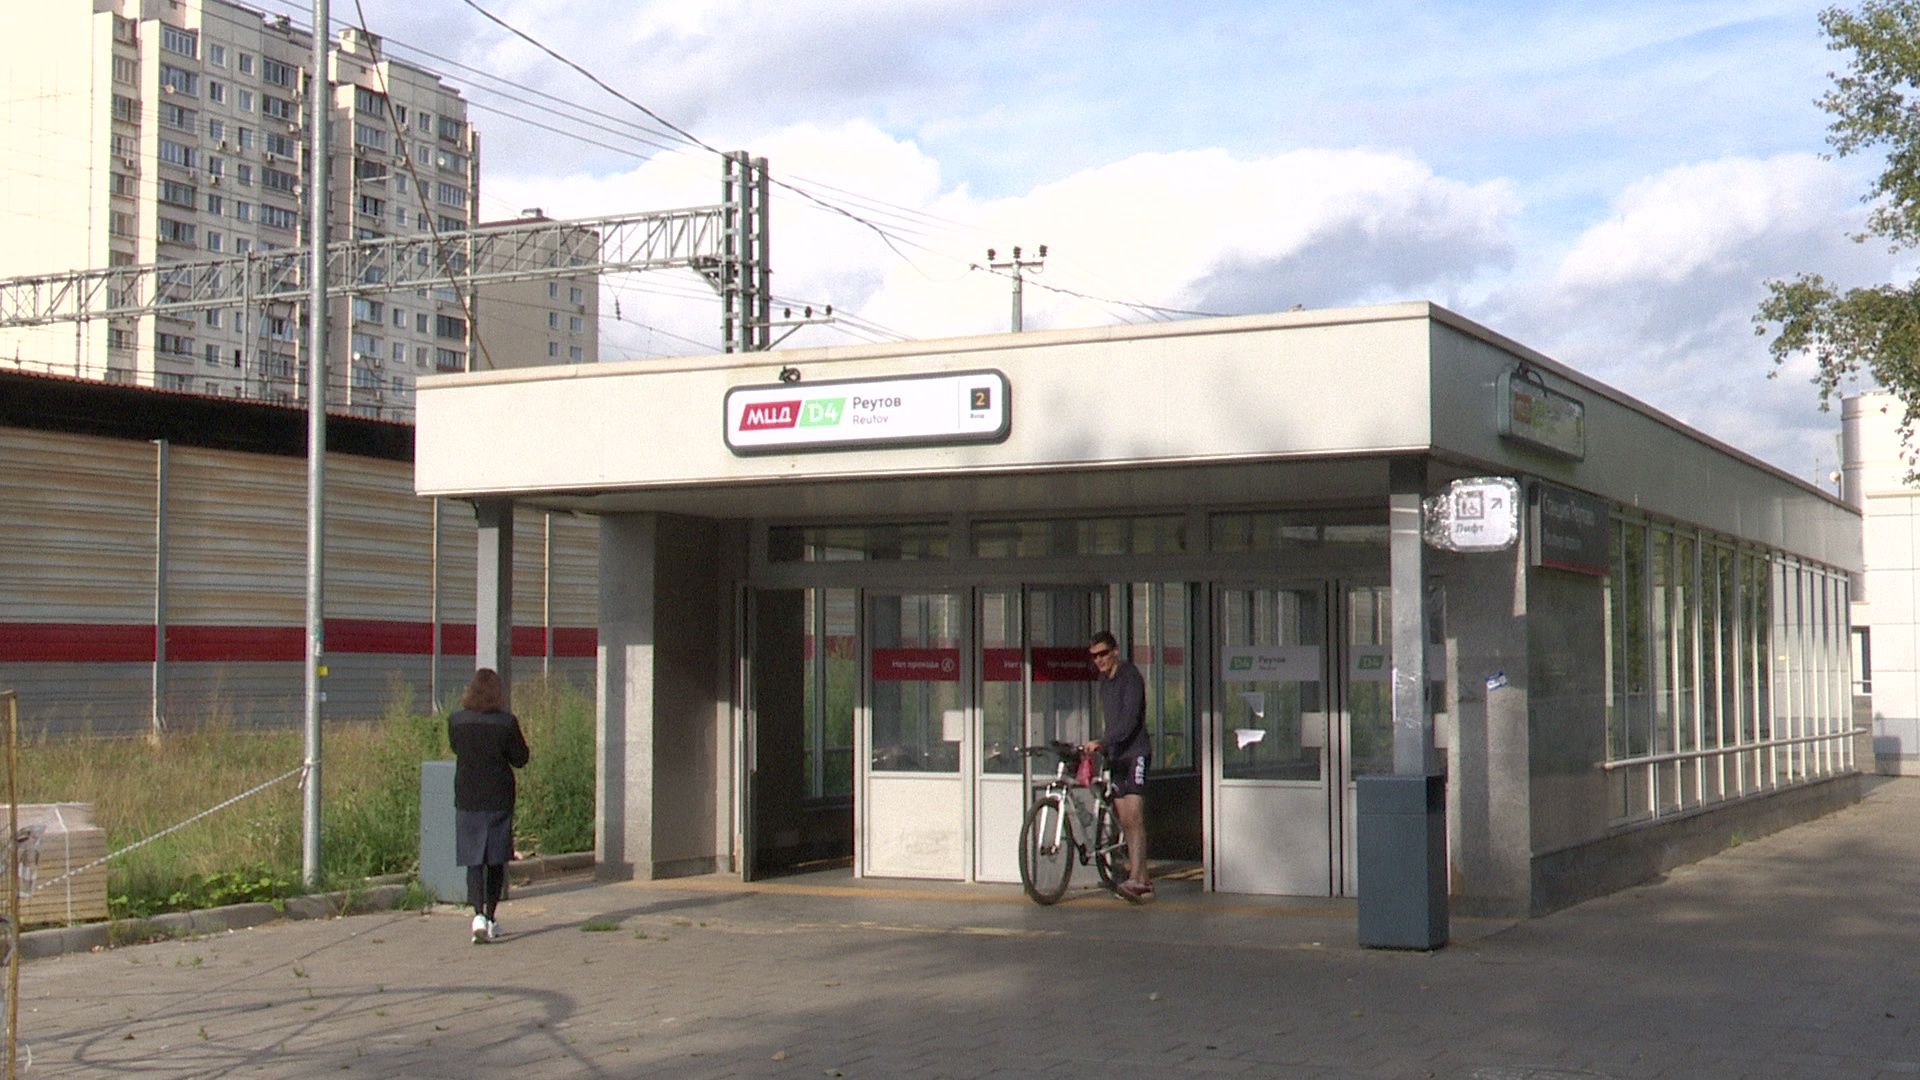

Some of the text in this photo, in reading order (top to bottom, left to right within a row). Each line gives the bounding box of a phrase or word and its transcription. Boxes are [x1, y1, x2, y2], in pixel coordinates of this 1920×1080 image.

[853, 396, 902, 411] Реутов
[975, 392, 985, 406] 2
[747, 406, 793, 426] МЦД
[808, 402, 838, 424] D4
[853, 414, 888, 425] Reutov
[1455, 523, 1484, 534] Лифт
